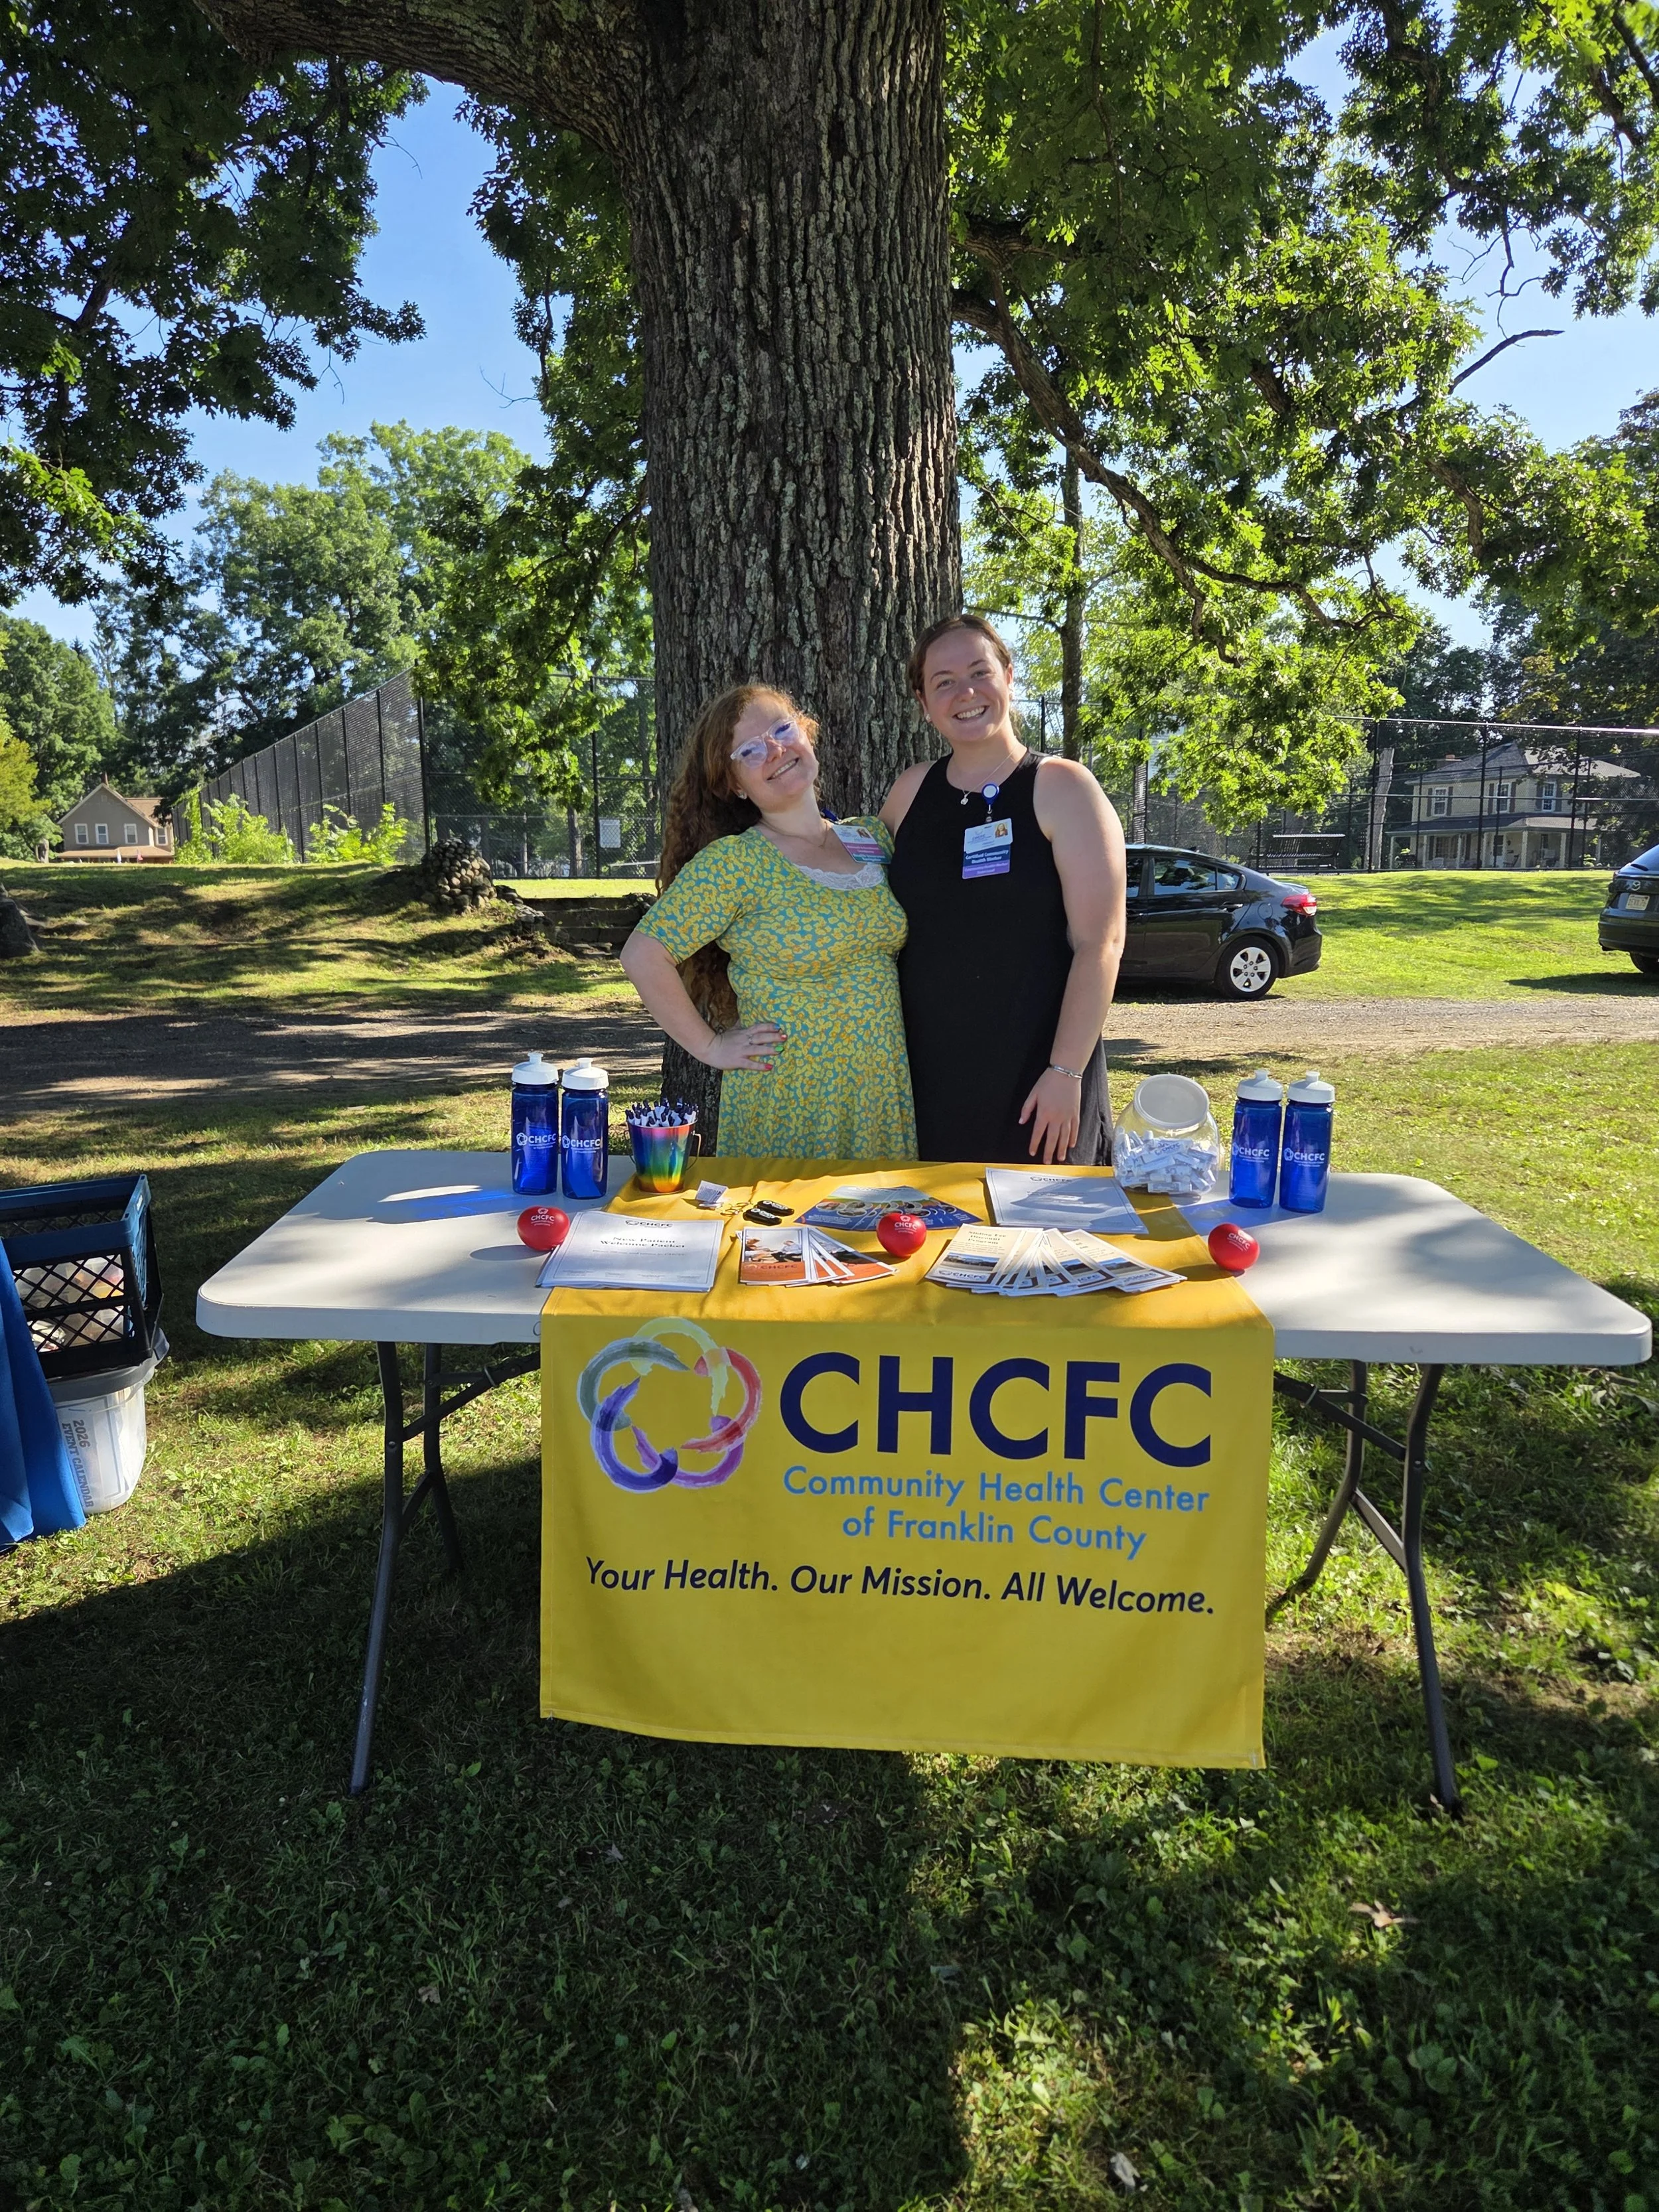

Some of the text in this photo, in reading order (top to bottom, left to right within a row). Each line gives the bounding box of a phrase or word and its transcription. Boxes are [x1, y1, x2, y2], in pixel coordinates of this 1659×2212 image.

[528, 1133, 556, 1143] CHCFC
[571, 1138, 601, 1147] CHCFC
[1239, 1147, 1270, 1157] CHCFC
[1293, 1151, 1325, 1161] CHCFC
[894, 1222, 917, 1230] CHCFC
[1228, 1232, 1251, 1250] CHCFC
[780, 1352, 1212, 1468] CHCFC
[72, 1419, 91, 1448] 2026
[62, 1422, 94, 1508] EVENT CALENDAR
[783, 1465, 1210, 1512] Community Health Center
[842, 1505, 1147, 1561] of Franklin County
[586, 1556, 1214, 1615] Your Health. Our Mission. All Welcome.
